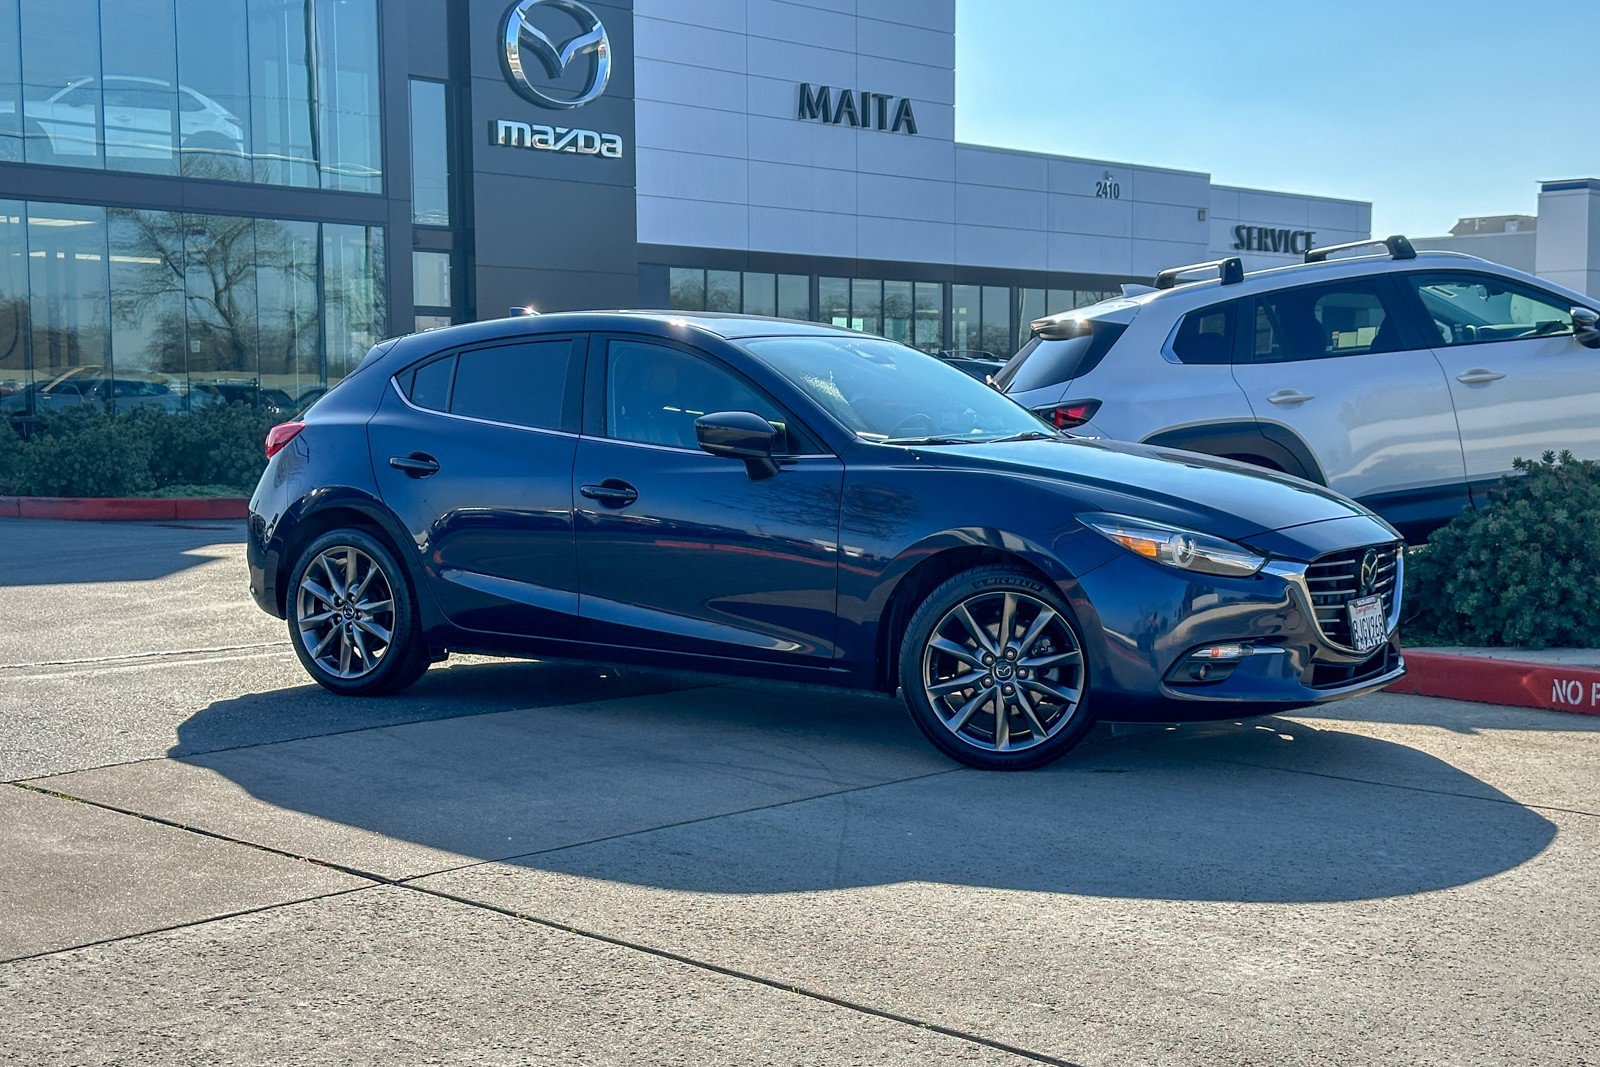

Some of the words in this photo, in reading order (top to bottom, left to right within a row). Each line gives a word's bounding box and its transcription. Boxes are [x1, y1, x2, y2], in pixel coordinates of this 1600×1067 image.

[798, 82, 918, 134] MAITA
[1095, 181, 1120, 199] 2410
[1234, 224, 1317, 254] SERVICE
[987, 578, 1040, 590] MICHELIN
[1357, 634, 1388, 650] MAITA
[1551, 678, 1583, 705] NO
